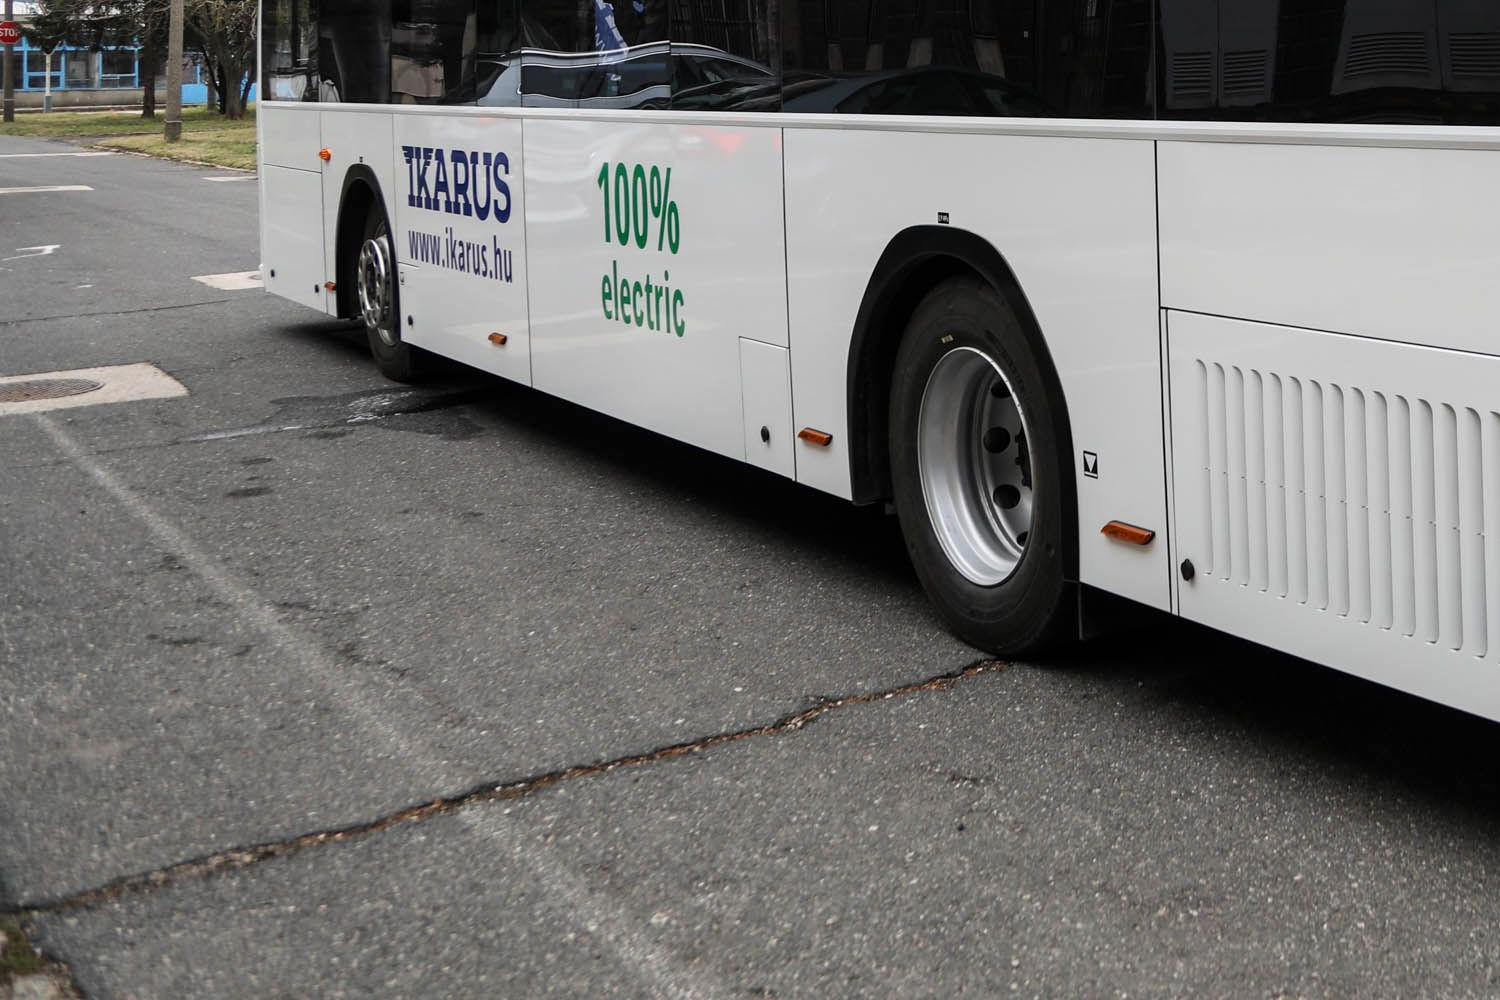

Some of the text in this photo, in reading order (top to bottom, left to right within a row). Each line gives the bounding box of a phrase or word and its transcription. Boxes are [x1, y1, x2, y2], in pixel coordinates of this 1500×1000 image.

[401, 145, 512, 224] IKARUS
[597, 162, 680, 255] 100%
[408, 226, 513, 284] www.ikarus.hu
[601, 260, 686, 338] electric
